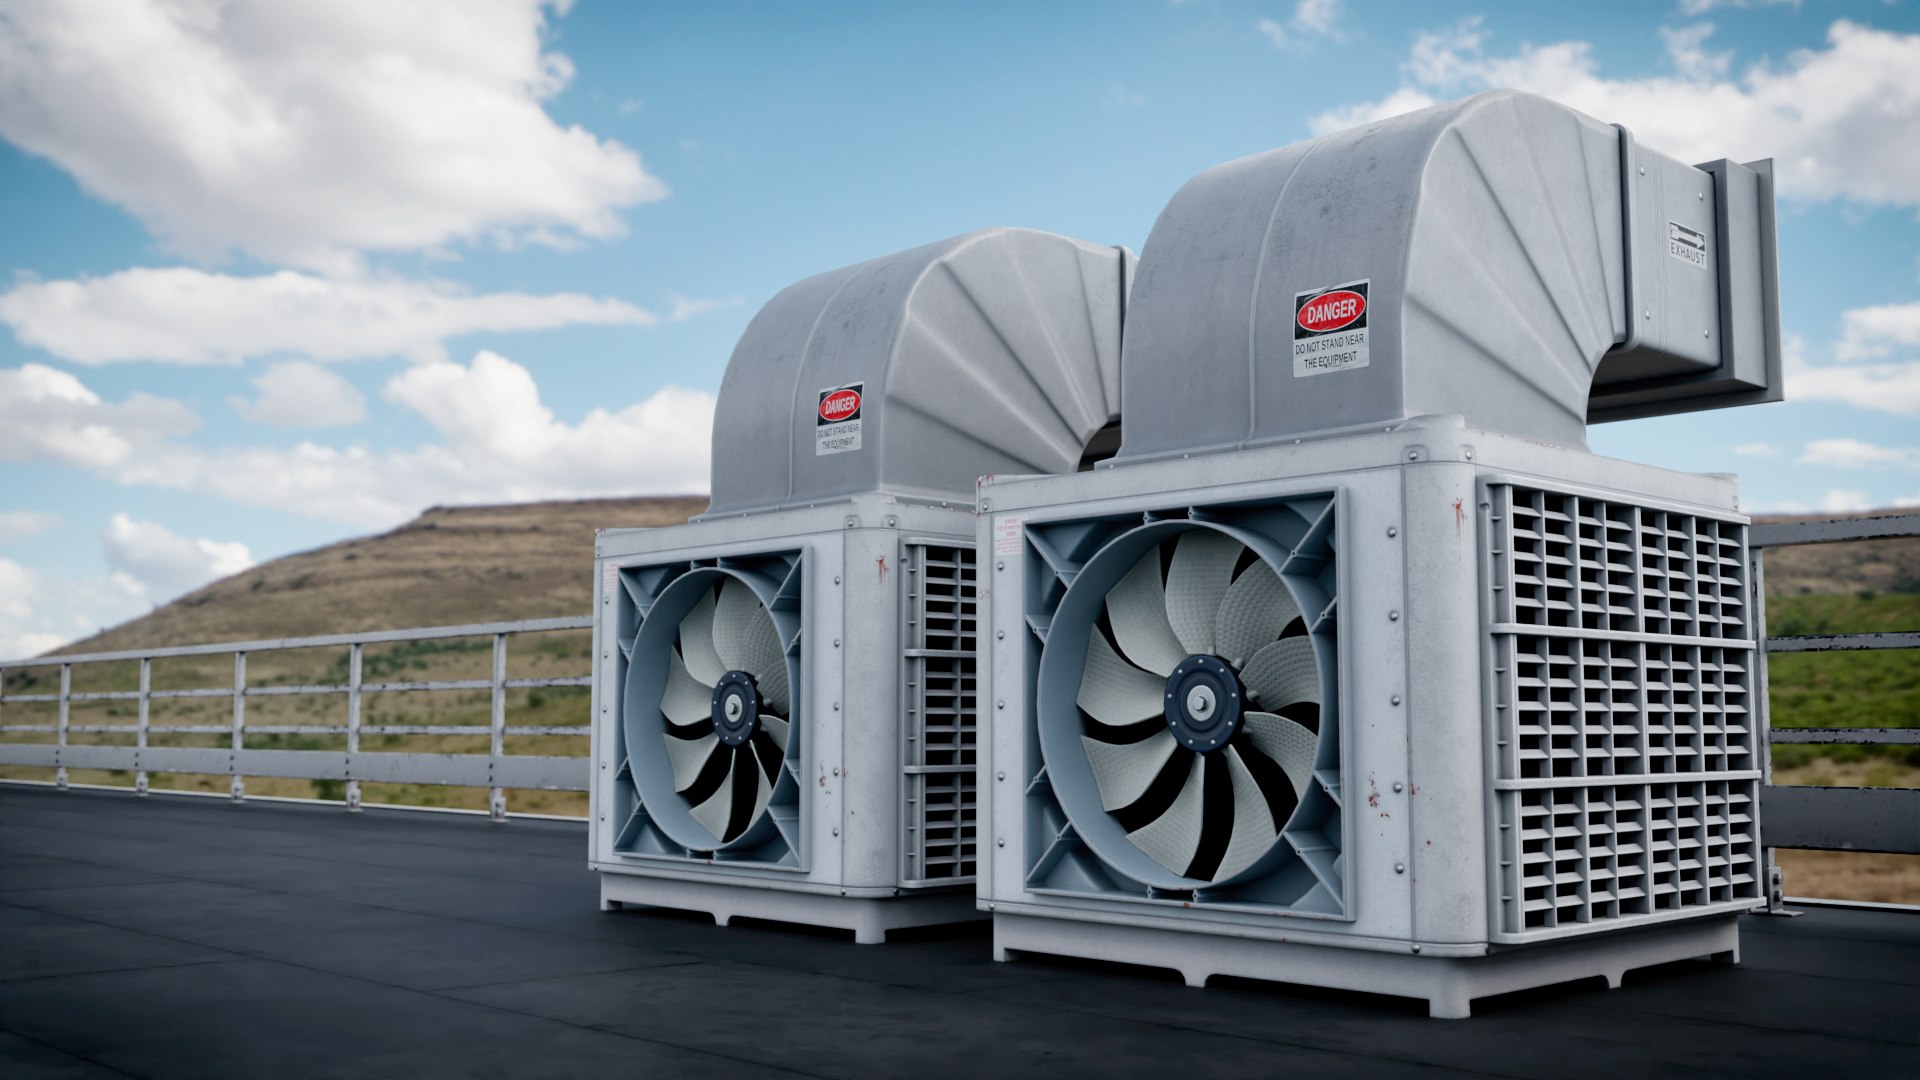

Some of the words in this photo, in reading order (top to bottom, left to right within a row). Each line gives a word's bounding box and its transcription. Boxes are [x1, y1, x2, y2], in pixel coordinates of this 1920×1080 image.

[1671, 241, 1705, 265] EXHAUST
[1307, 298, 1357, 325] DANGER
[1295, 344, 1305, 355] DO
[1306, 341, 1320, 354] NOT
[1321, 337, 1344, 351] STAND
[1345, 333, 1365, 346] NEAR
[1304, 357, 1317, 370] THE
[1318, 351, 1358, 369] EQUIPMENT
[825, 396, 856, 415] DANGER
[824, 427, 832, 438] NOT
[833, 424, 847, 436] STAND
[848, 423, 859, 433] NEAR
[822, 441, 830, 449] THE
[831, 436, 855, 450] EQUIPMENT
